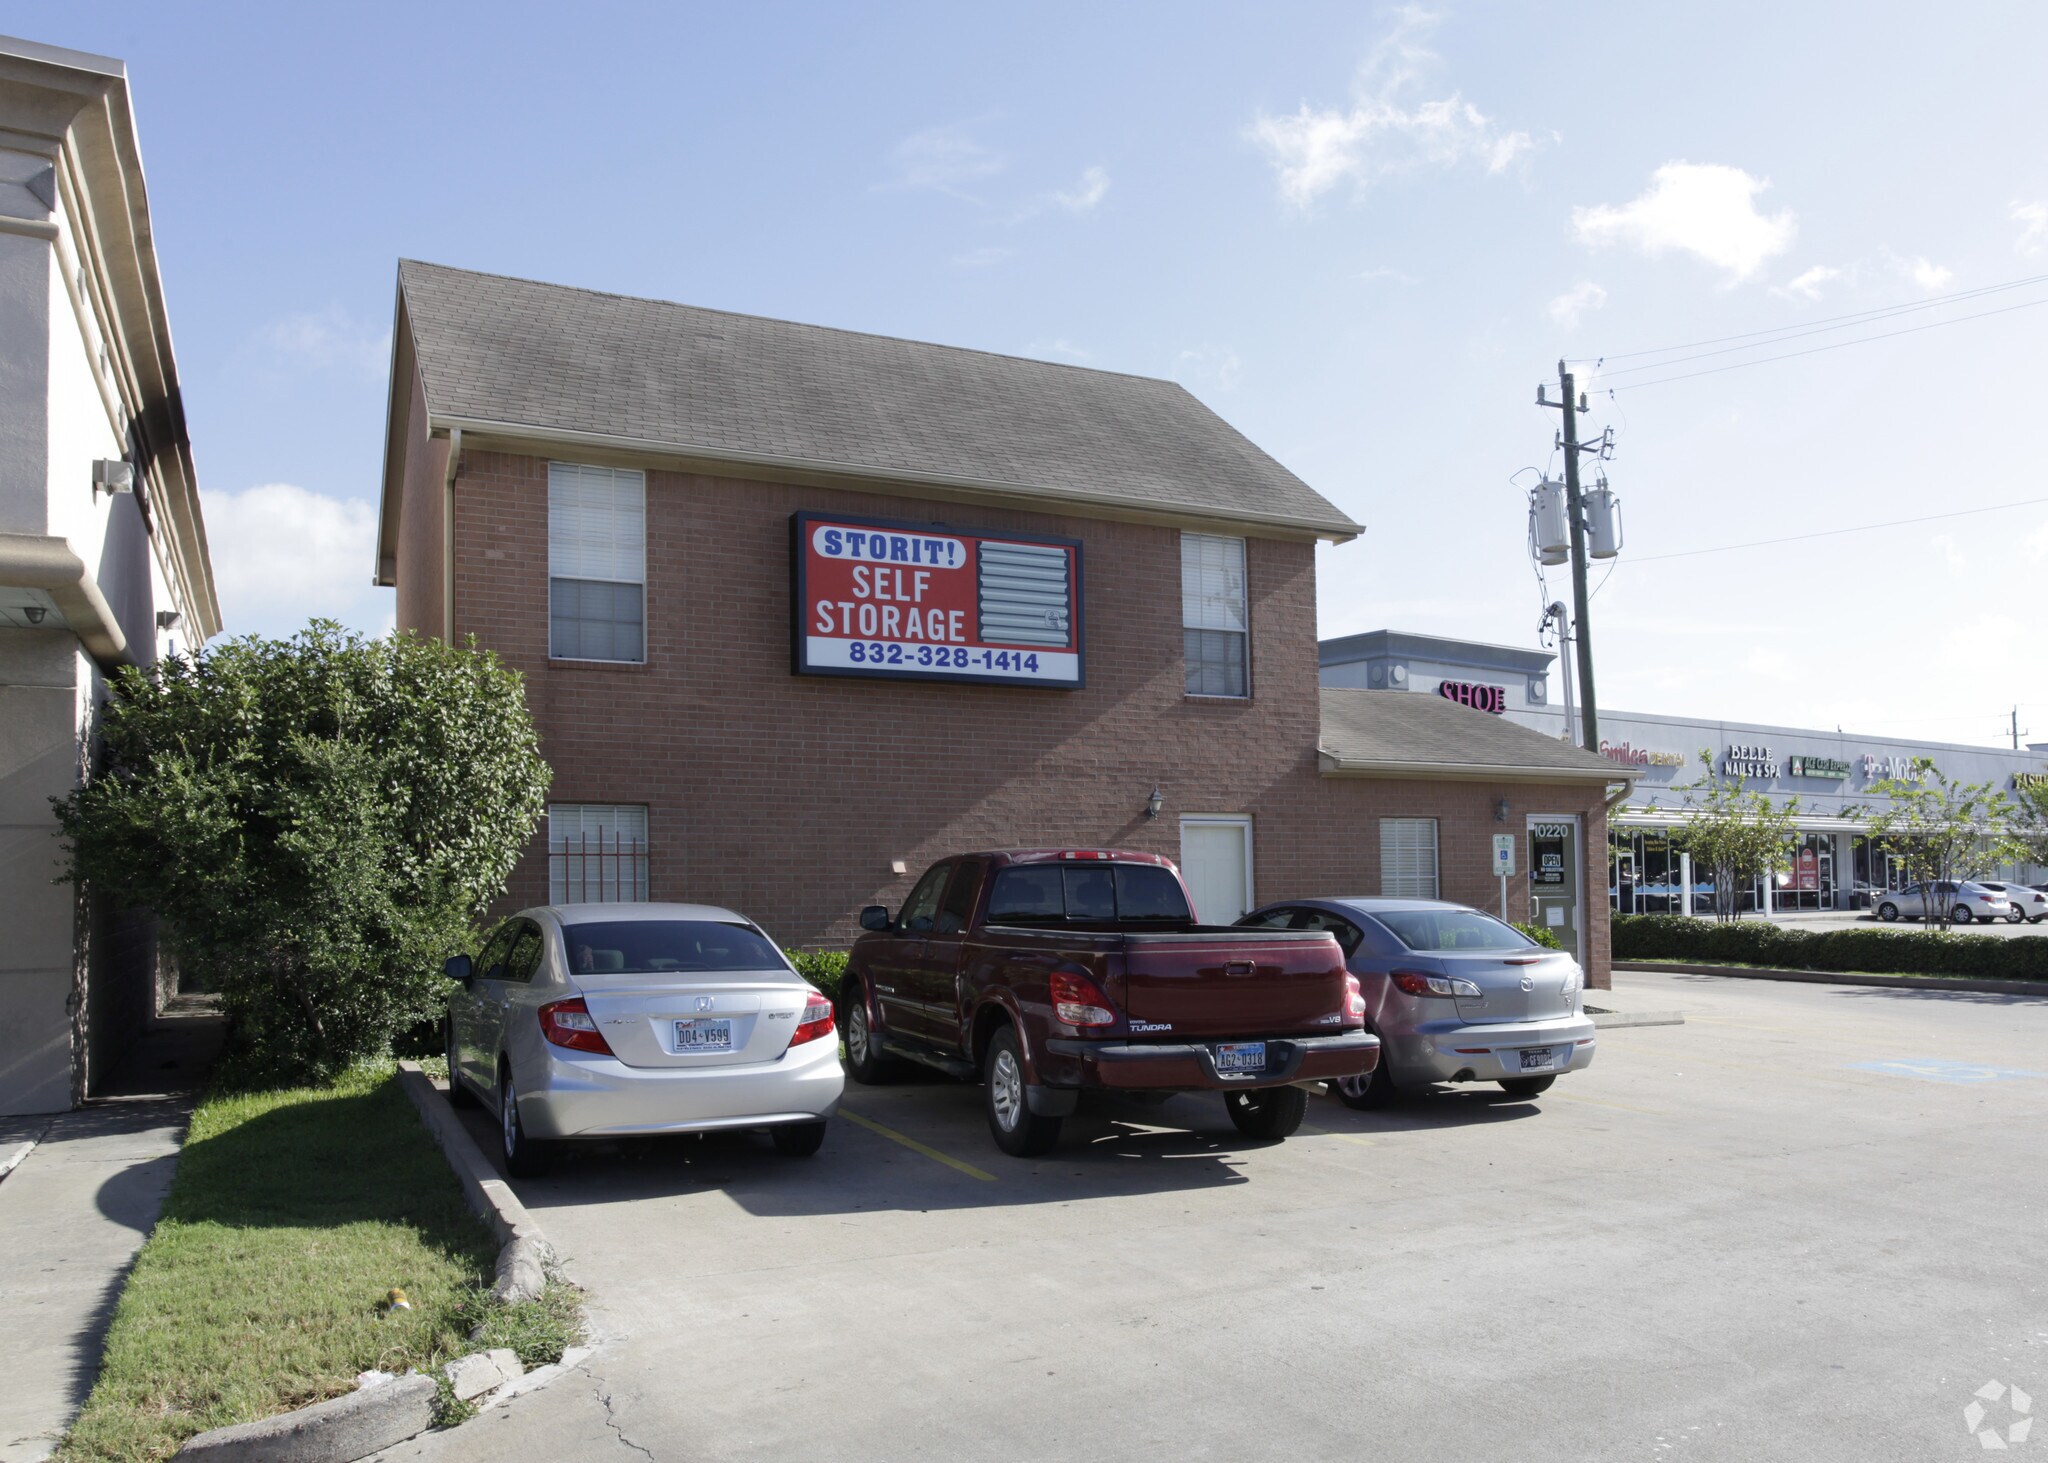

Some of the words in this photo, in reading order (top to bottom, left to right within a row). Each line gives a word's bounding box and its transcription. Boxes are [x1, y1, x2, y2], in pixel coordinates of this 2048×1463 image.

[824, 530, 955, 566] STORIT!
[852, 565, 931, 602] SELF
[815, 600, 966, 642] STORAGE
[850, 642, 1039, 673] 832-328-1414
[1441, 680, 1506, 713] SHOE
[1600, 740, 1648, 764] Smiles
[1731, 745, 1773, 761] BELLE
[1725, 761, 1753, 777] NAILS
[1755, 764, 1762, 777] &
[1764, 764, 1781, 778] SPA
[1534, 824, 1568, 838] 10220
[1543, 855, 1560, 866] OPEN
[1130, 1024, 1172, 1032] TUNDRA
